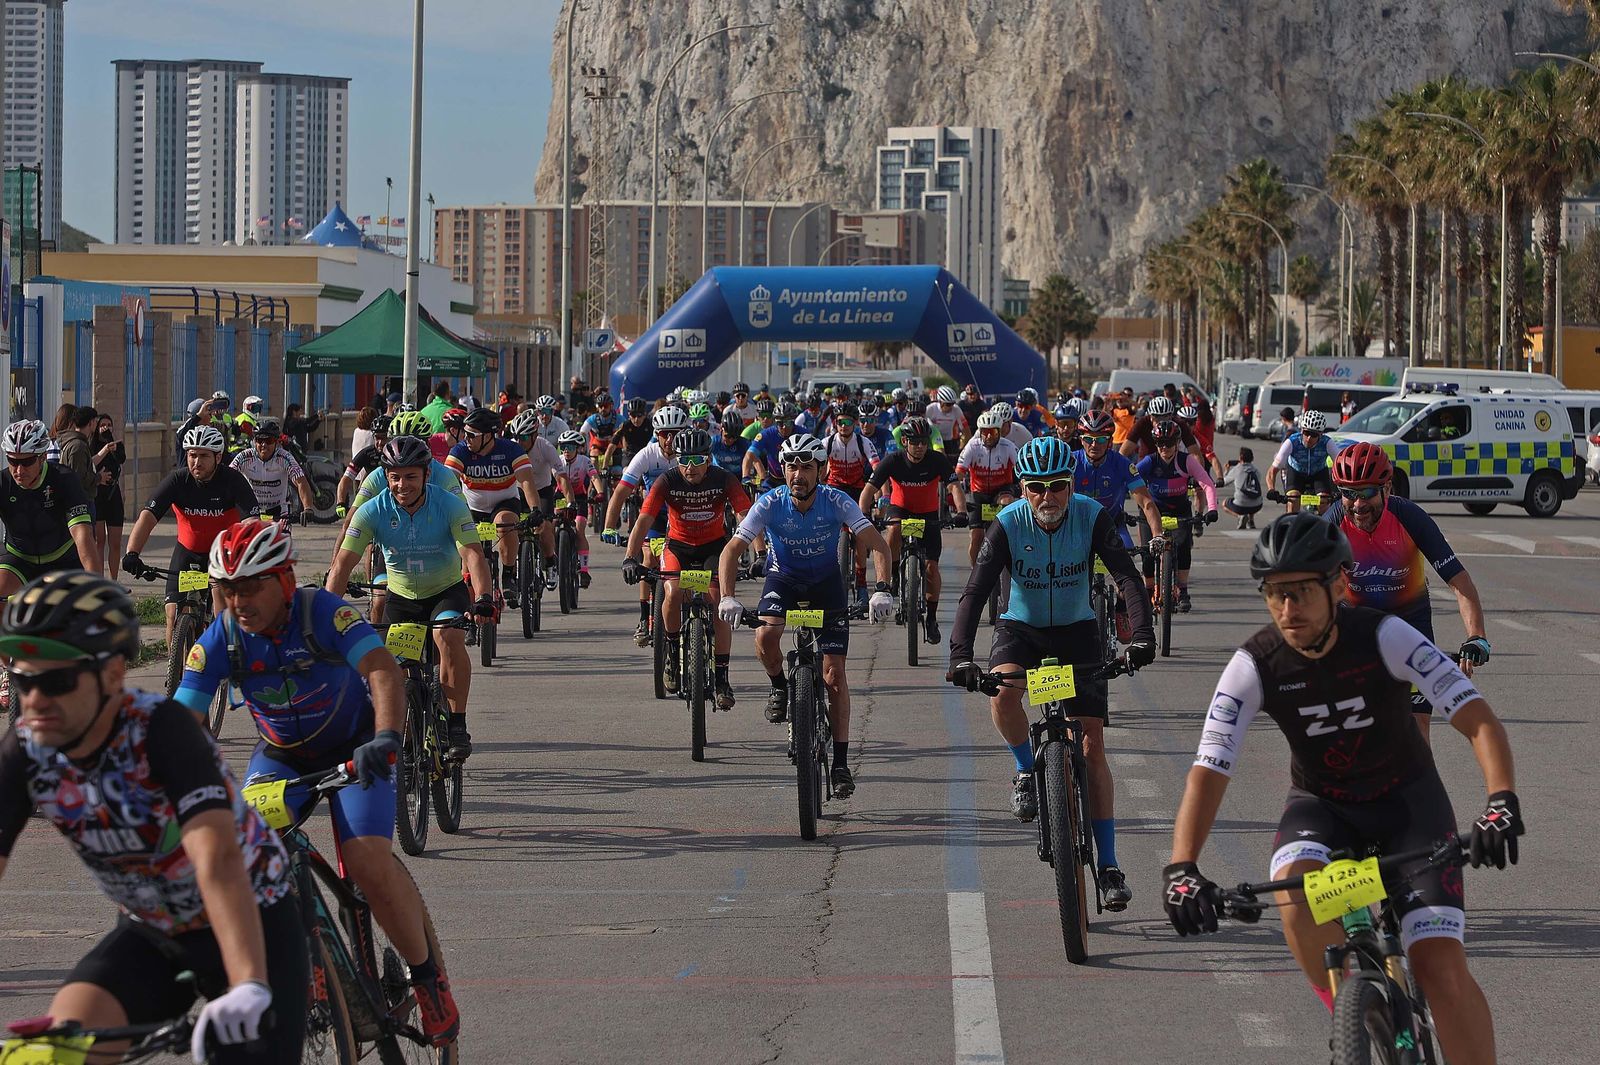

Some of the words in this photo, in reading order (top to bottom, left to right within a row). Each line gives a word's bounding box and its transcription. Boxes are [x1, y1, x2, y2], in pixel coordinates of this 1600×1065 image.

[778, 287, 908, 307] Ayuntamiento
[792, 309, 815, 324] de
[818, 309, 840, 324] La
[844, 308, 894, 324] Línea
[664, 335, 676, 348] D
[950, 353, 998, 362] DEPORTES
[658, 360, 705, 368] DEPORTES
[1299, 362, 1352, 377] Decolor
[1493, 410, 1525, 419] UNIDAD
[1494, 421, 1527, 431] CANINA
[1480, 489, 1512, 497] LOCAL
[1024, 581, 1050, 589] Bike
[398, 632, 416, 642] 217
[1041, 675, 1061, 684] 265
[1328, 867, 1358, 884] 128
